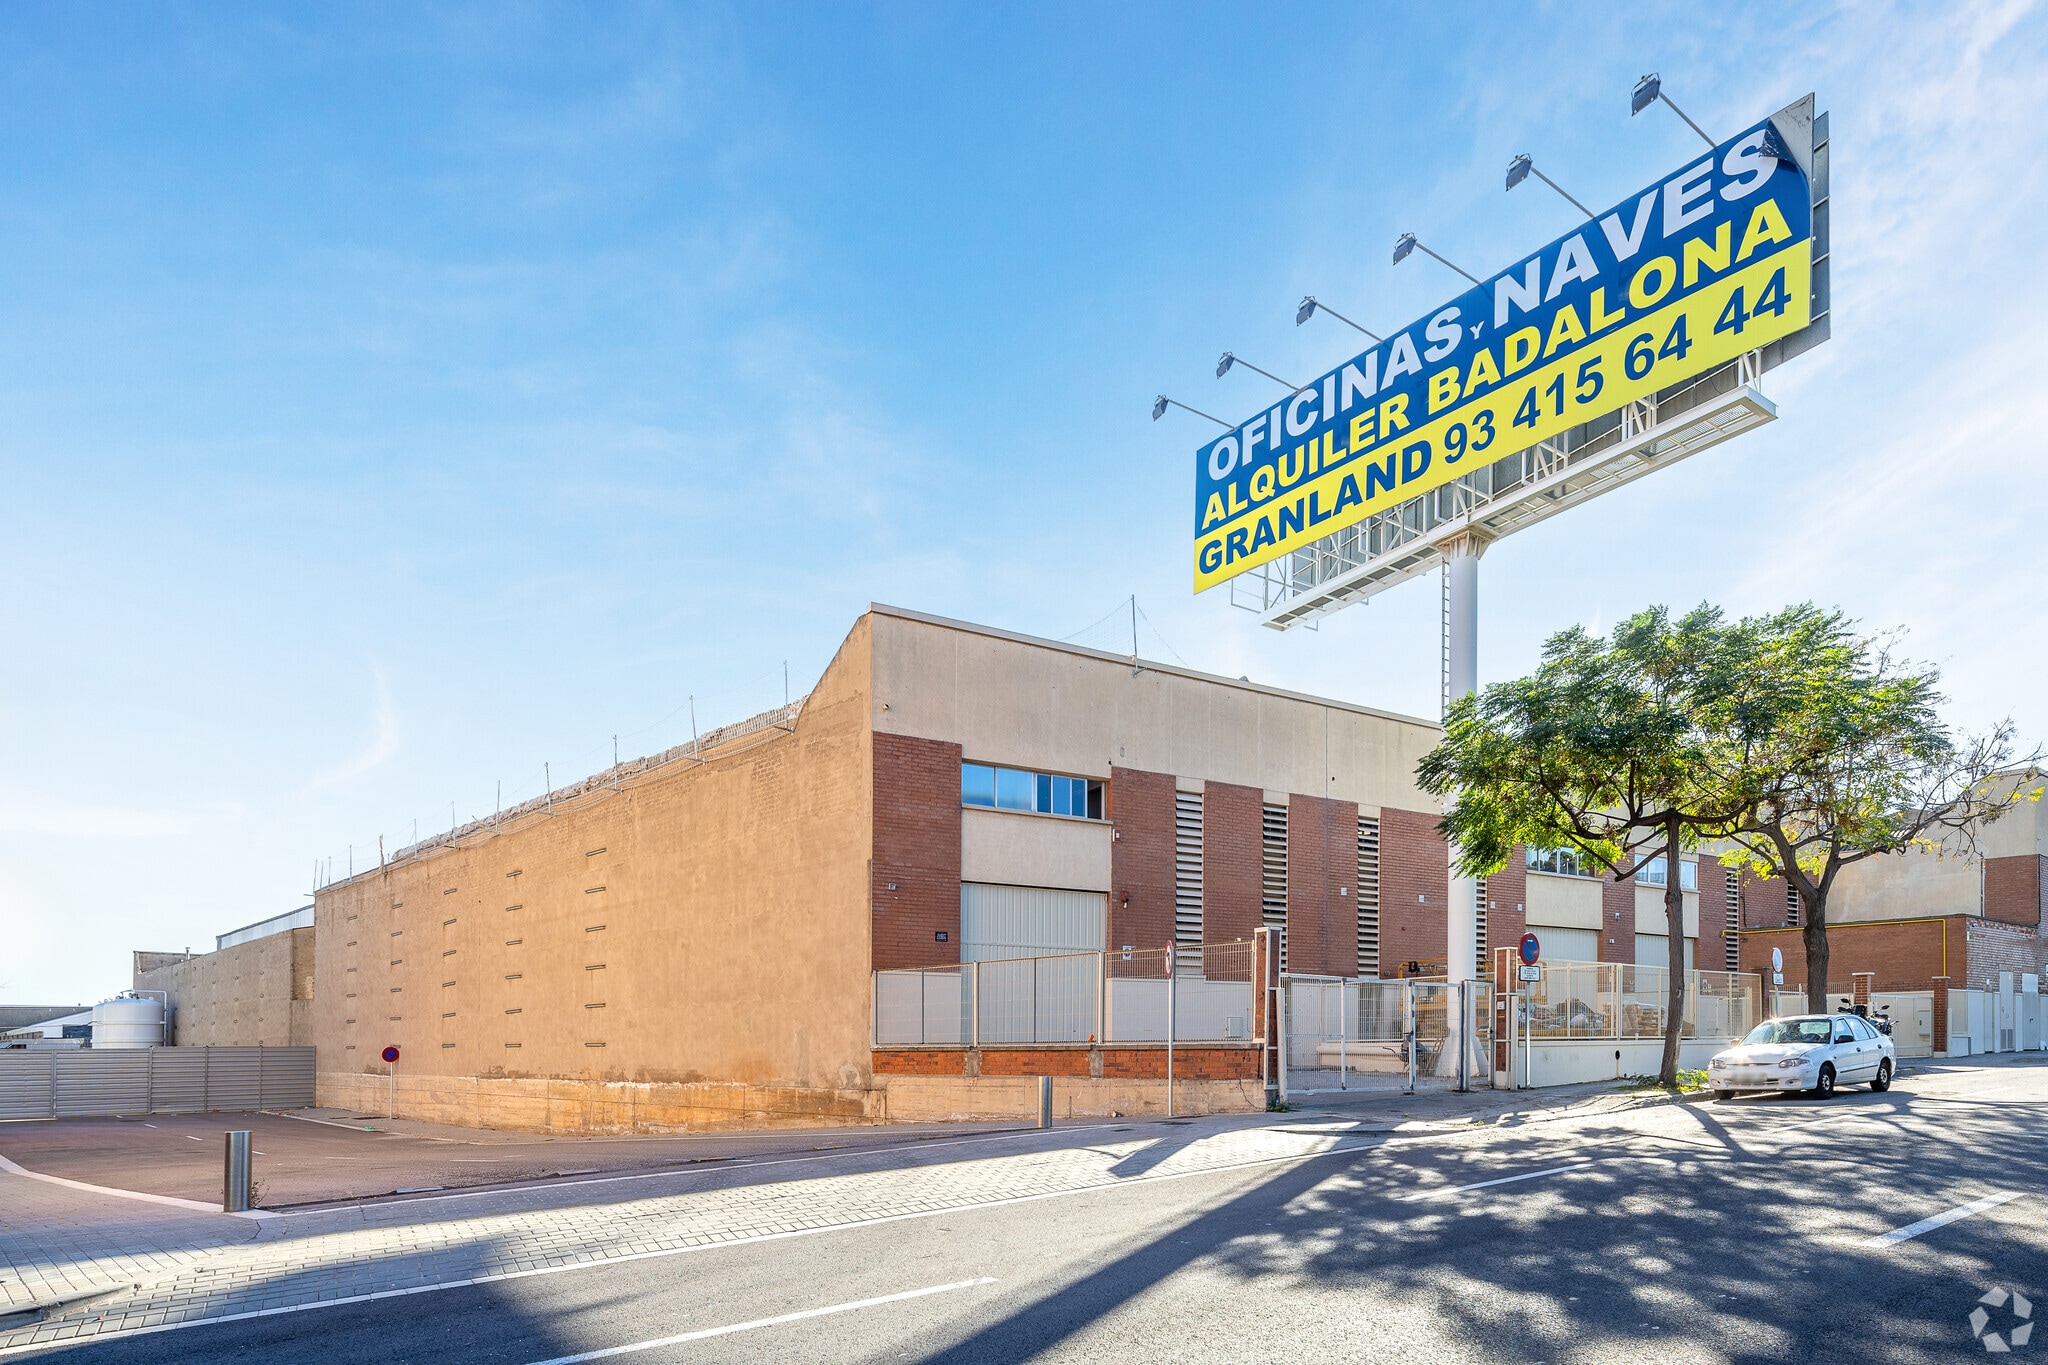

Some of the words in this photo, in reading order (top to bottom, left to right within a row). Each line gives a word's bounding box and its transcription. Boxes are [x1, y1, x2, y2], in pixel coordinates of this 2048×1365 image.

[1199, 440, 1432, 574] GRANLAND
[1444, 409, 1496, 464] 93
[1512, 355, 1604, 429] 415
[1624, 313, 1692, 381] 64
[1713, 266, 1791, 336] 44
[1201, 393, 1411, 530] ALQUILER
[1428, 198, 1792, 415] BADALONA
[1208, 306, 1462, 481] OFICINAS
[1494, 129, 1778, 329] NAVES
